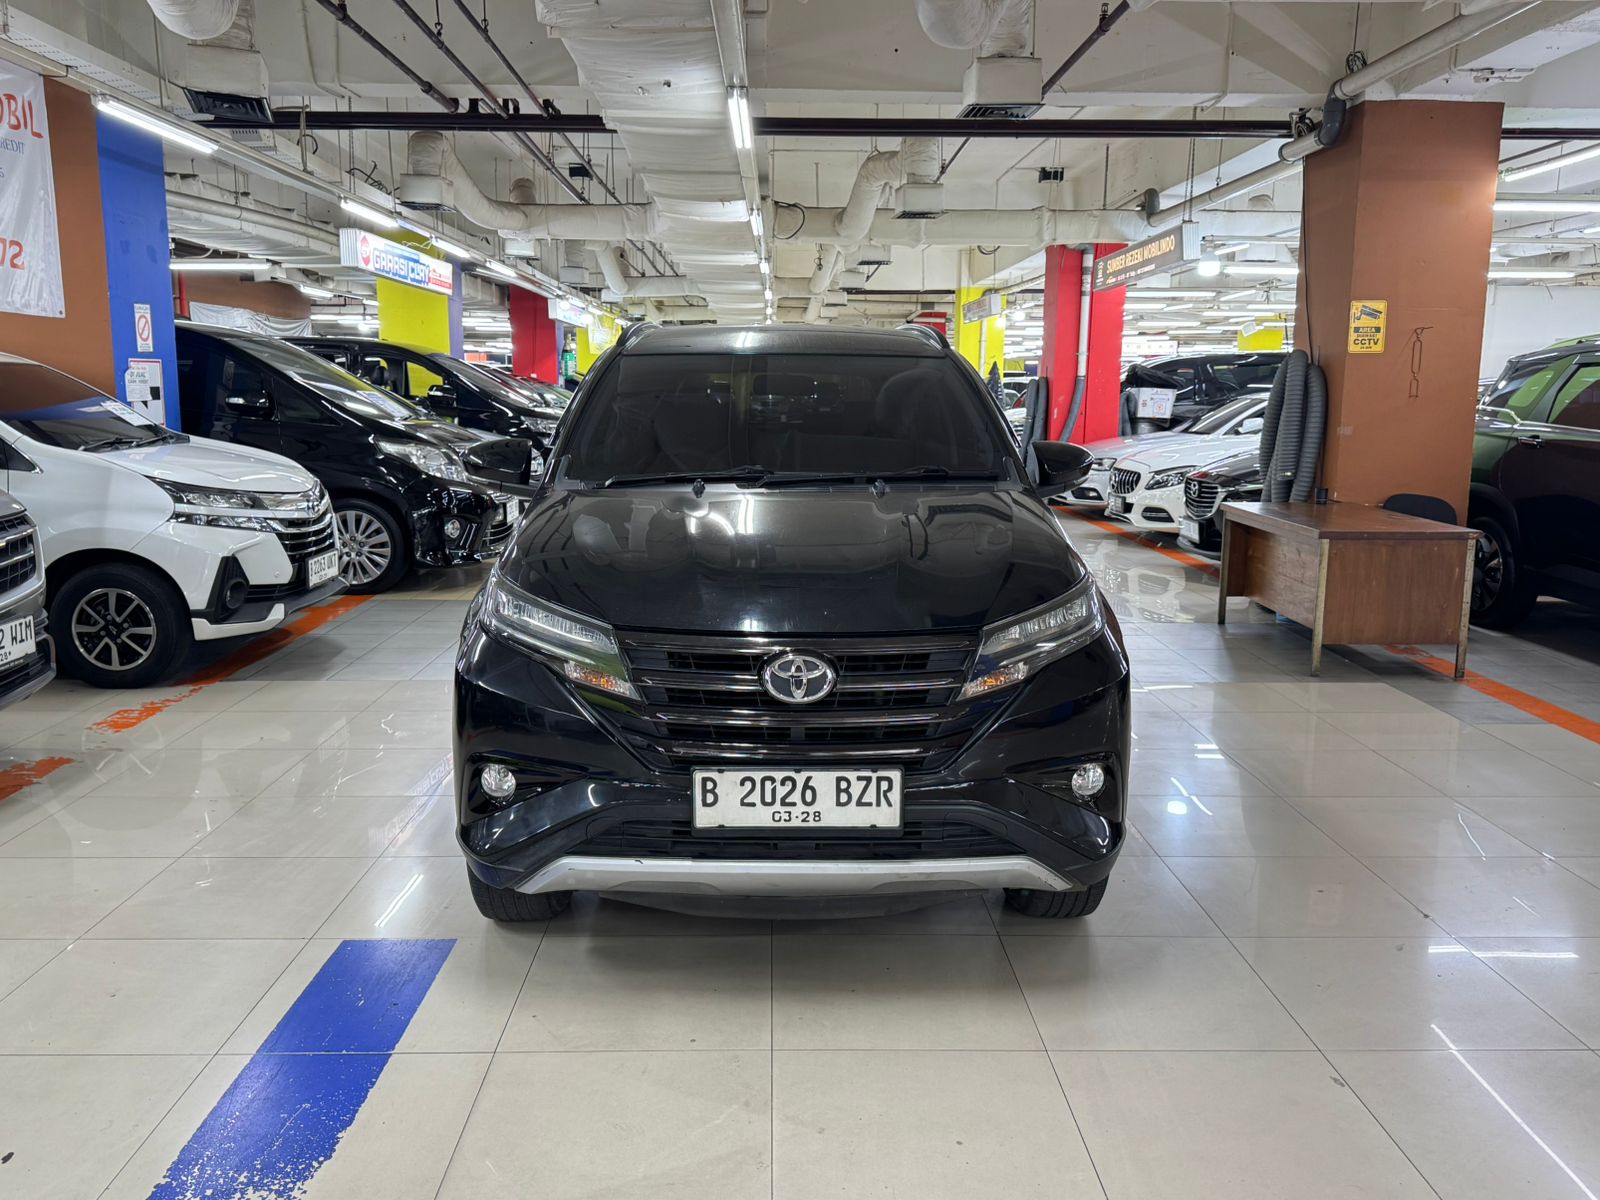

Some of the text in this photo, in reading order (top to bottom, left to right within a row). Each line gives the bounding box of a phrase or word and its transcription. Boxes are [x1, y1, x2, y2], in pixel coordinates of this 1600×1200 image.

[0, 93, 44, 139] BIL
[373, 249, 408, 278] GARASI
[408, 262, 430, 286] CLAY
[1106, 254, 1126, 274] SUMBER
[1143, 234, 1175, 261] MOBILINDO
[1353, 338, 1380, 346] CCTV
[10, 619, 33, 647] WIM
[701, 775, 894, 808] B 2026 BZR
